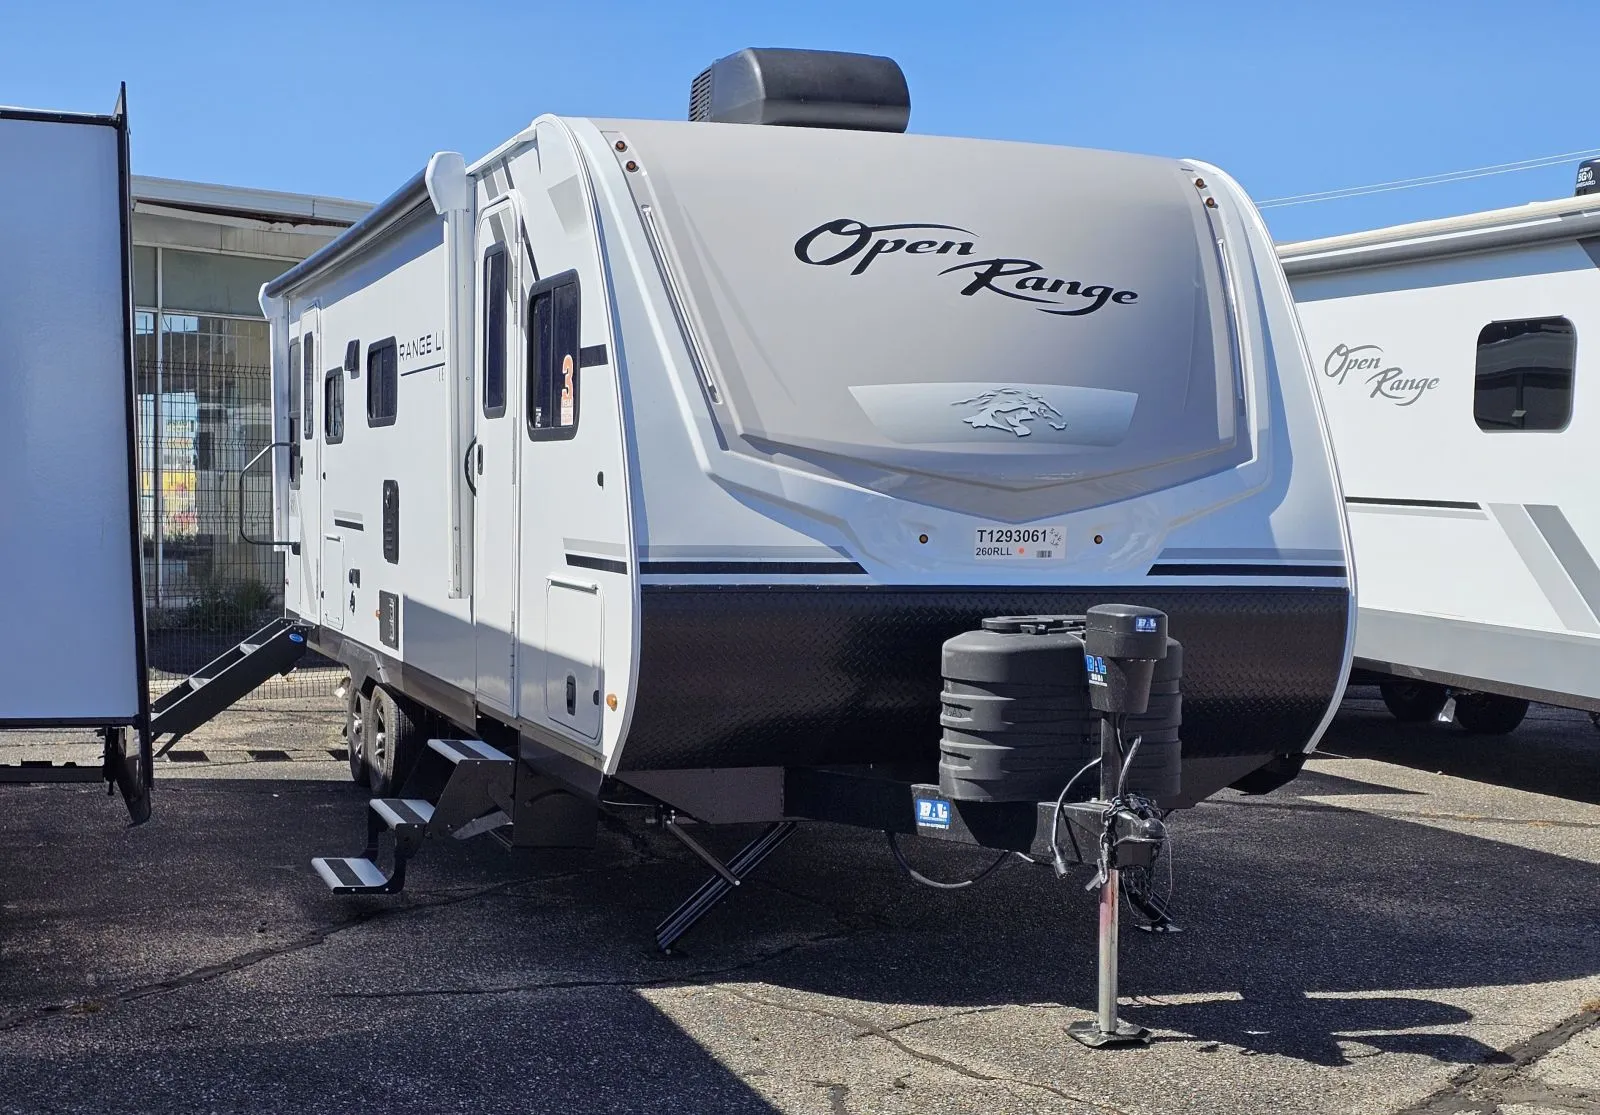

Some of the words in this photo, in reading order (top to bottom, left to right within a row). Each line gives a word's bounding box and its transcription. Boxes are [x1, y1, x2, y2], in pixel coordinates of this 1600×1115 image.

[1578, 172, 1587, 182] 5G
[794, 219, 980, 276] Open
[937, 258, 1139, 316] Range
[399, 334, 432, 361] RANGE
[1324, 343, 1384, 385] Open
[562, 354, 573, 401] 3
[1364, 367, 1440, 406] Range
[975, 547, 1012, 556] 260RLL
[977, 529, 1047, 542] T1293061
[919, 801, 948, 818] BAL
